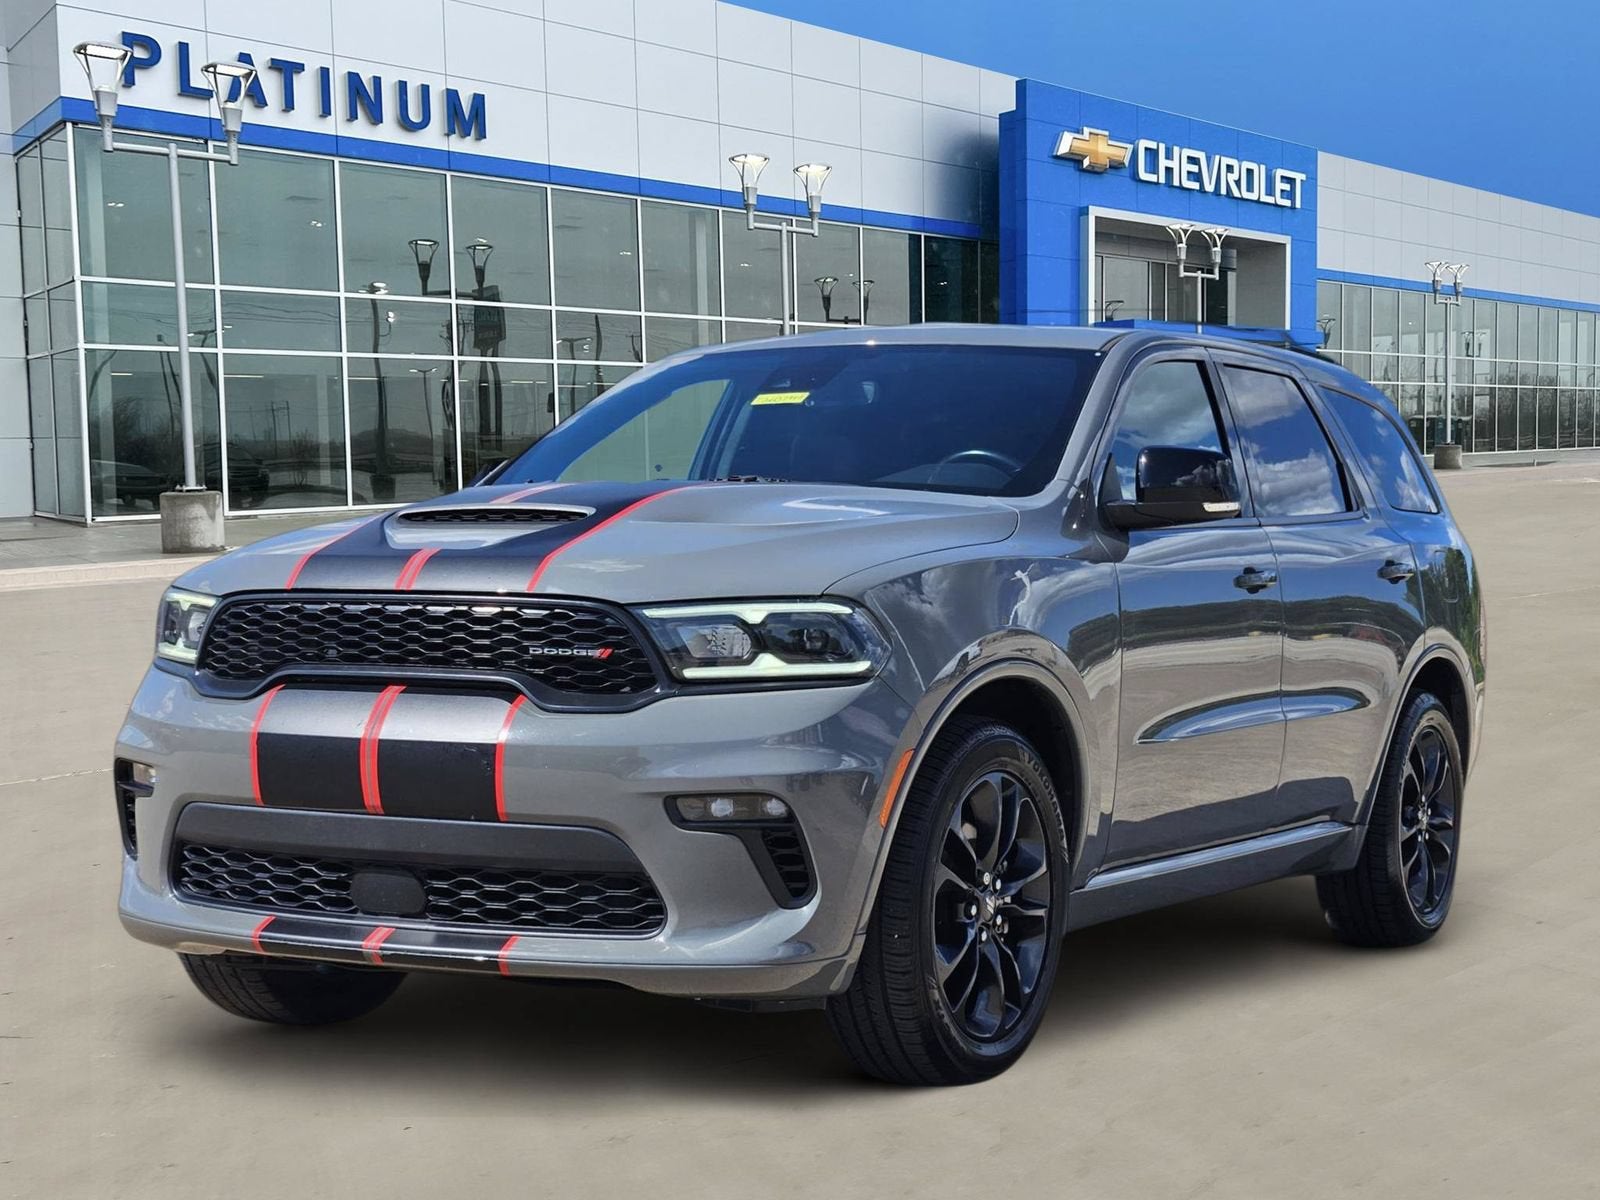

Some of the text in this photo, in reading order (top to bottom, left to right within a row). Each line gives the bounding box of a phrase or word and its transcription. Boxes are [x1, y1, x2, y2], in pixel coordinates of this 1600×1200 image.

[121, 31, 487, 141] PLATINUM
[1135, 139, 1306, 209] CHEVROLET
[529, 647, 598, 656] DODGE
